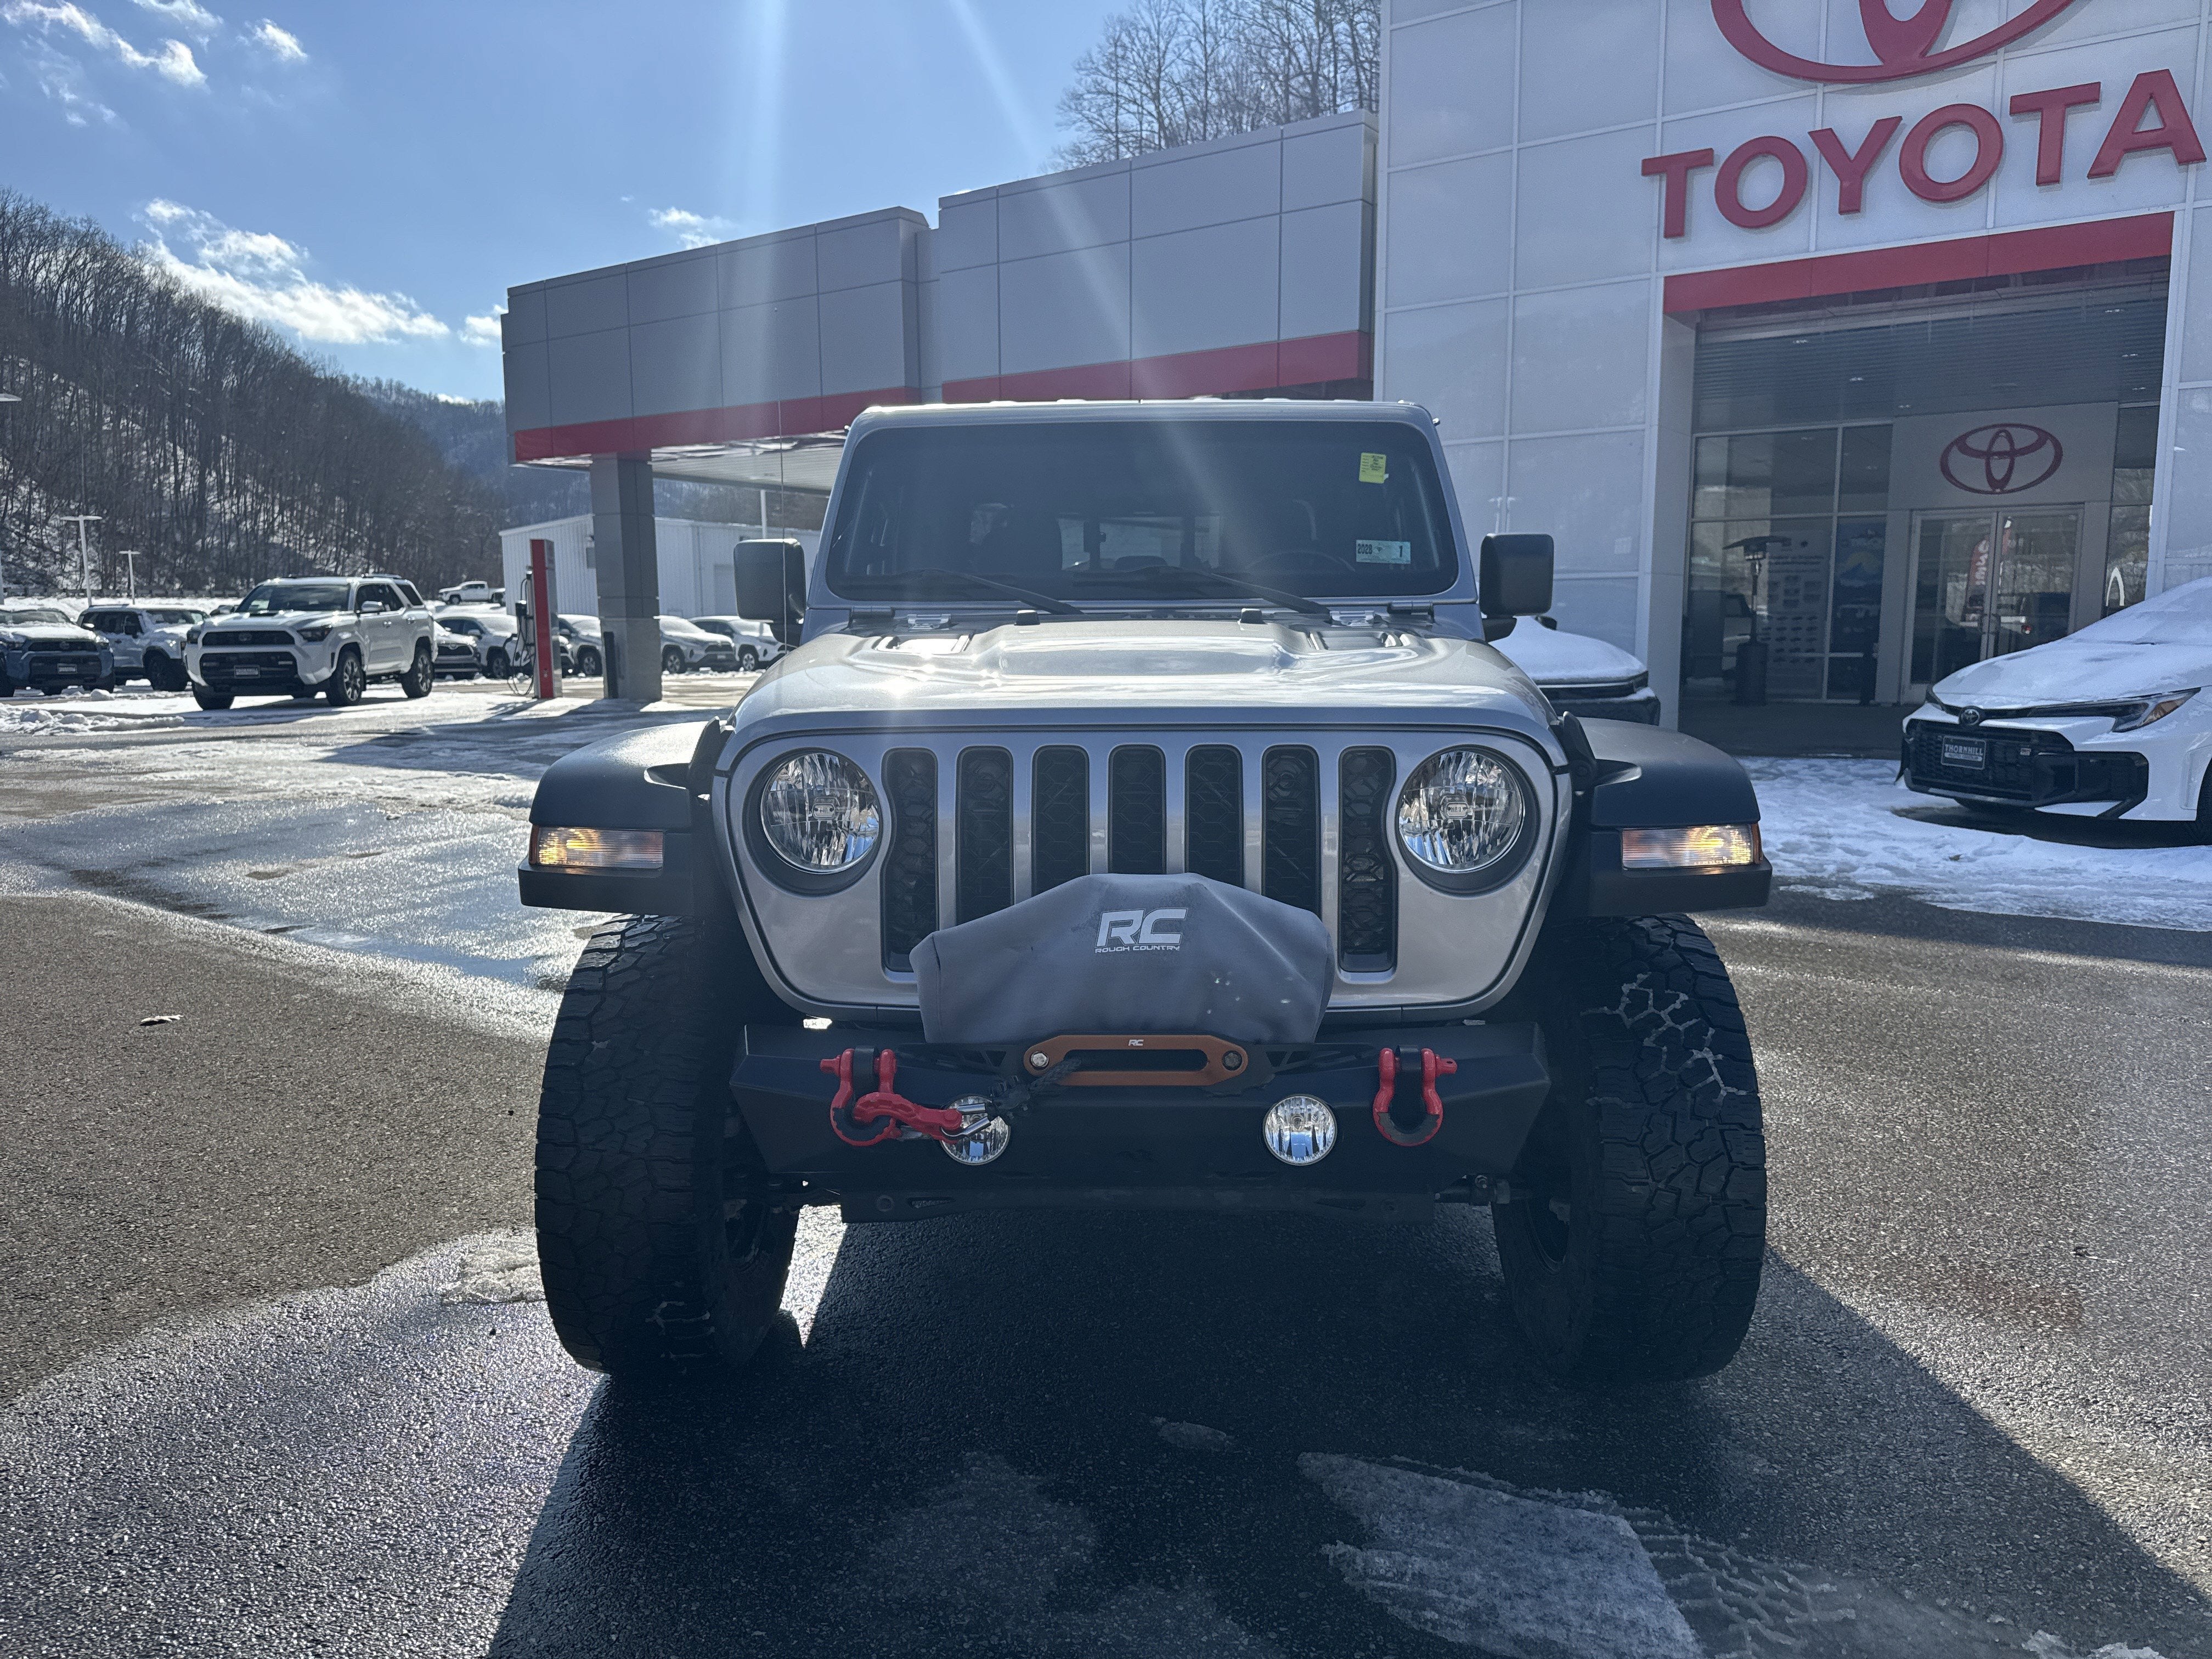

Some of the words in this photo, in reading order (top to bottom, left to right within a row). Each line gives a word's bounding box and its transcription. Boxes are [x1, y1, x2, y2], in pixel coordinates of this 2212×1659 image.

[1641, 69, 2206, 239] TOYOTA
[1357, 543, 1373, 555] 2028
[1944, 744, 1983, 755] THORNHILL
[1096, 907, 1188, 947] RC
